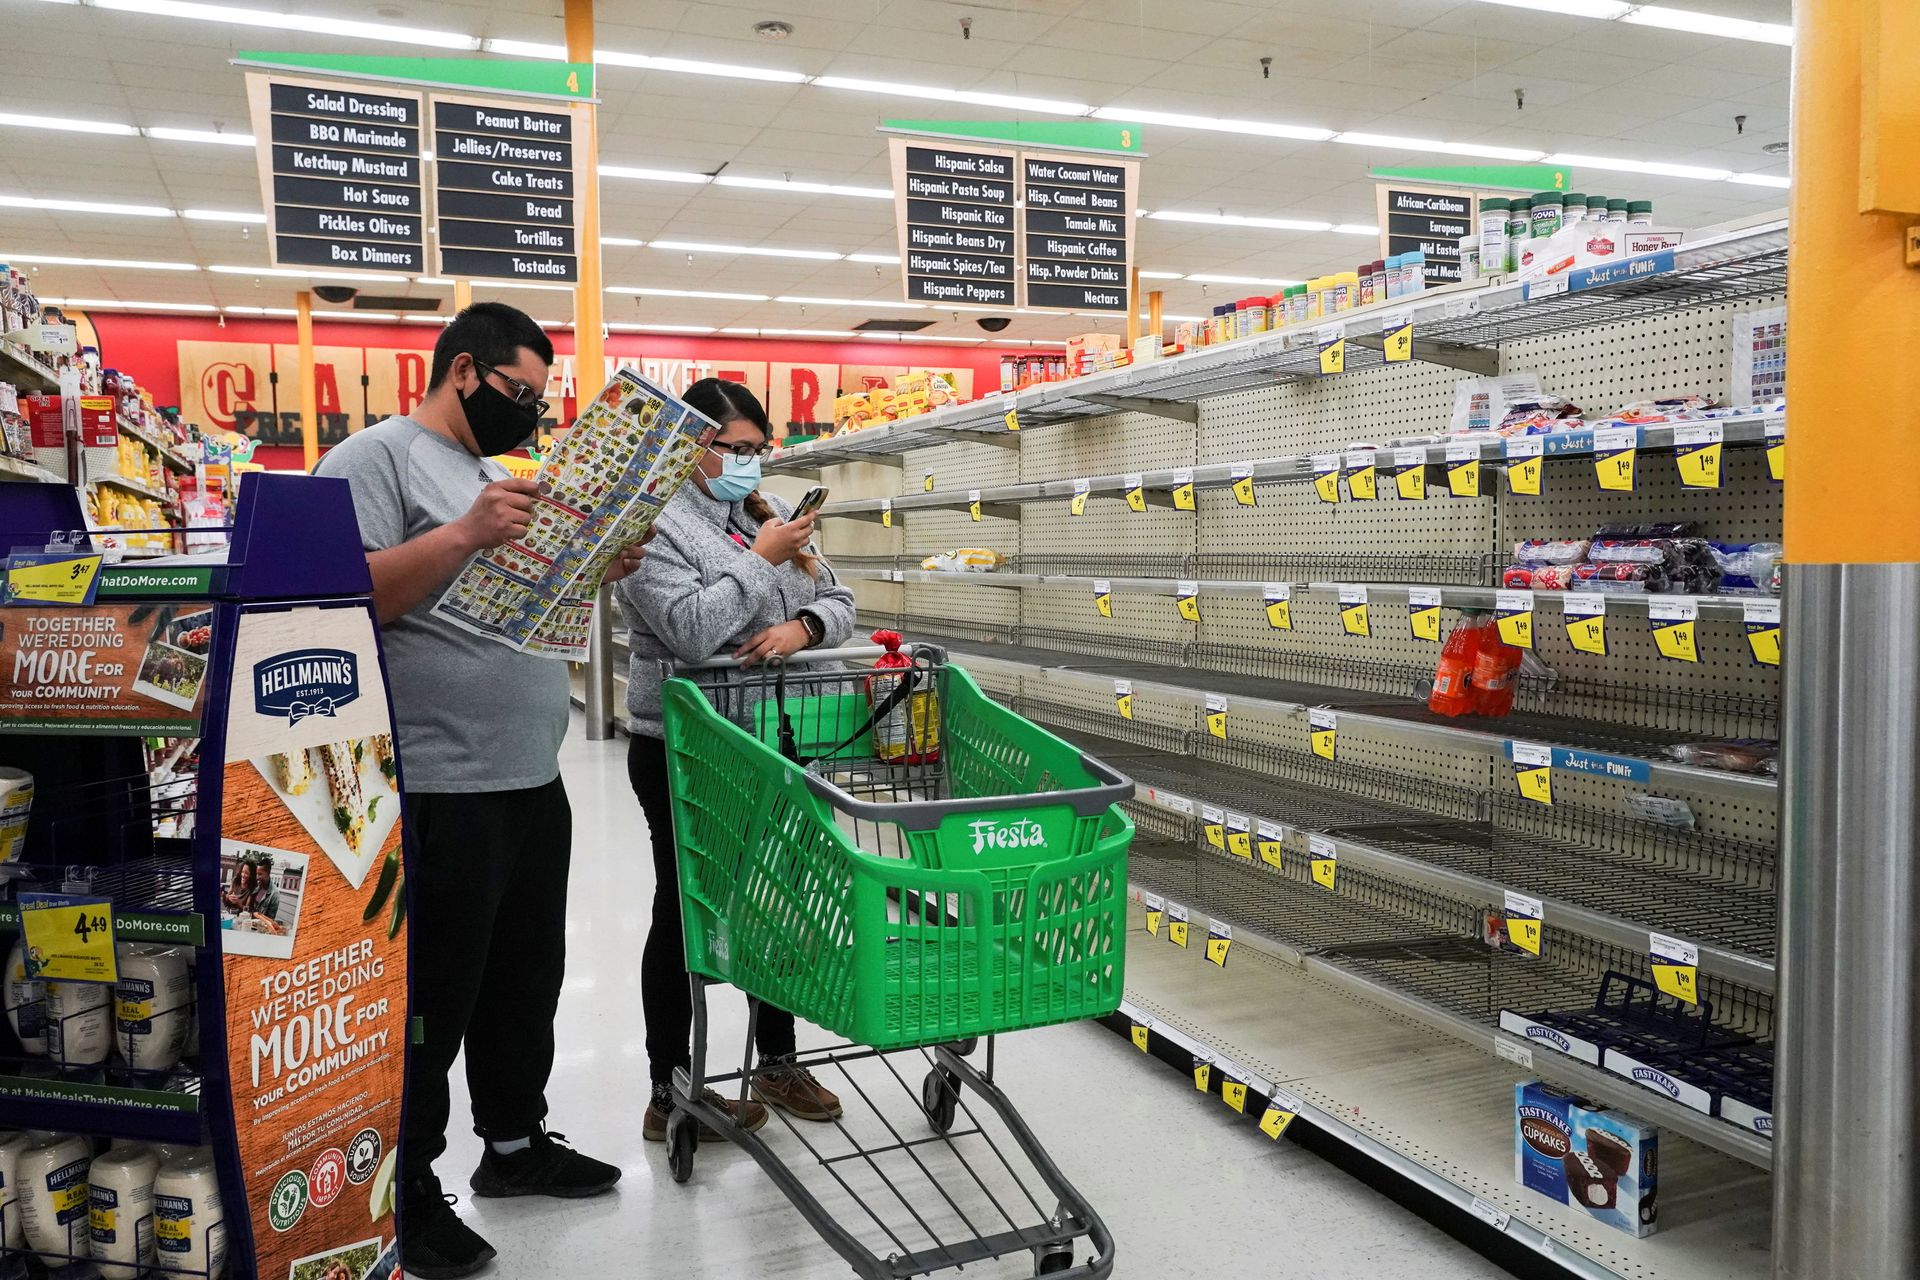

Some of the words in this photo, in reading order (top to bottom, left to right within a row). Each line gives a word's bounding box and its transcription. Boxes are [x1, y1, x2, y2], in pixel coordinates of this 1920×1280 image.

[566, 72, 578, 92] 4
[308, 94, 344, 113] Salad
[349, 99, 407, 122] Dressing
[476, 112, 520, 129] Peanut
[523, 117, 561, 134] Butter
[310, 125, 340, 142] BBQ
[344, 128, 407, 148] Marinade
[1122, 130, 1131, 147] 3
[453, 139, 562, 162] Jellies/Preserves
[294, 153, 348, 175] Ketchup
[352, 158, 408, 177] Mustard
[936, 155, 975, 172] Hispanic
[979, 158, 1004, 174] Salsa
[1029, 164, 1055, 178] Water
[1058, 167, 1090, 181] Coconut
[1092, 170, 1118, 184] Water
[492, 171, 522, 188] Cake
[526, 175, 563, 190] Treats
[910, 179, 949, 195] Hispanic
[952, 181, 979, 197] Pasta
[982, 186, 1005, 201] Soup
[1555, 173, 1562, 188] 2
[344, 187, 369, 202] Hot
[372, 191, 409, 206] Sauce
[1028, 190, 1051, 205] Hisp.
[1054, 192, 1086, 205] Canned
[1091, 194, 1117, 208] Beans
[1397, 196, 1464, 212] African-Caribbean
[527, 203, 562, 218] Bread
[942, 207, 982, 223] Hispanic
[985, 210, 1004, 223] Rice
[319, 215, 365, 233] Pickles
[369, 219, 411, 236] Olives
[1065, 217, 1096, 230] Tamale
[1099, 220, 1117, 232] Mix
[1430, 221, 1464, 235] European
[515, 231, 563, 247] Tortillas
[913, 230, 953, 247] Hispanic
[956, 233, 984, 248] Beans
[988, 236, 1005, 252] Dry
[1048, 240, 1085, 254] Hispanic
[1088, 243, 1117, 256] Coffee
[1420, 242, 1436, 255] Mid
[332, 246, 358, 262] Box
[362, 248, 411, 264] Dinners
[512, 259, 566, 274] Tostadas
[911, 256, 950, 272] Hispanic
[954, 259, 1005, 275] Spices/Tea
[1030, 264, 1052, 280] Hisp.
[1055, 266, 1088, 279] Powder
[1091, 268, 1118, 280] Drinks
[1440, 265, 1461, 278] Merch
[1587, 269, 1610, 283] Just
[924, 282, 964, 298] Hispanic
[967, 285, 1005, 300] Peppers
[1085, 292, 1118, 304] Nectars
[234, 411, 350, 446] FREH
[1562, 436, 1583, 450] Just
[98, 575, 197, 587] hatDoMore.com
[27, 617, 116, 631] TOGETHER
[18, 634, 70, 648] WE'RE
[72, 634, 123, 647] DOING
[13, 650, 96, 685] MORE
[95, 664, 123, 675] FOR
[261, 656, 352, 696] HELLMANN'S
[35, 687, 121, 698] COMMUNITY
[1566, 752, 1589, 769] Just
[968, 817, 1045, 855] Fiesta
[115, 919, 189, 933] DoMore.com
[260, 938, 373, 1000] TOGETHER
[251, 984, 319, 1029] WE'RE
[323, 958, 384, 1000] DOING
[251, 995, 355, 1088] MORE
[356, 998, 388, 1026] FOR
[1527, 1027, 1569, 1050] TASTYKAKE
[253, 1088, 284, 1109] YOUR
[286, 1029, 389, 1093] COMMUNITY
[1633, 1069, 1678, 1096] TASTYKAKE
[282, 1124, 306, 1142] JUNTOS
[308, 1108, 336, 1127] ESTAMOS
[337, 1091, 368, 1112] HACIENDO
[302, 1128, 315, 1142] POR
[317, 1122, 325, 1135] TU
[326, 1105, 362, 1128] COMUNIDAD
[1520, 1107, 1571, 1136] TASTYKAKE
[349, 1132, 378, 1161] SUSTAINABLE
[1523, 1125, 1566, 1152] CUPKAKES
[51, 1160, 89, 1185] HELLMANN
[311, 1152, 343, 1181] COMMUNITY
[350, 1157, 377, 1181] SOURCING
[272, 1174, 306, 1205] DELICIOUSLY
[316, 1186, 339, 1202] IMPACT
